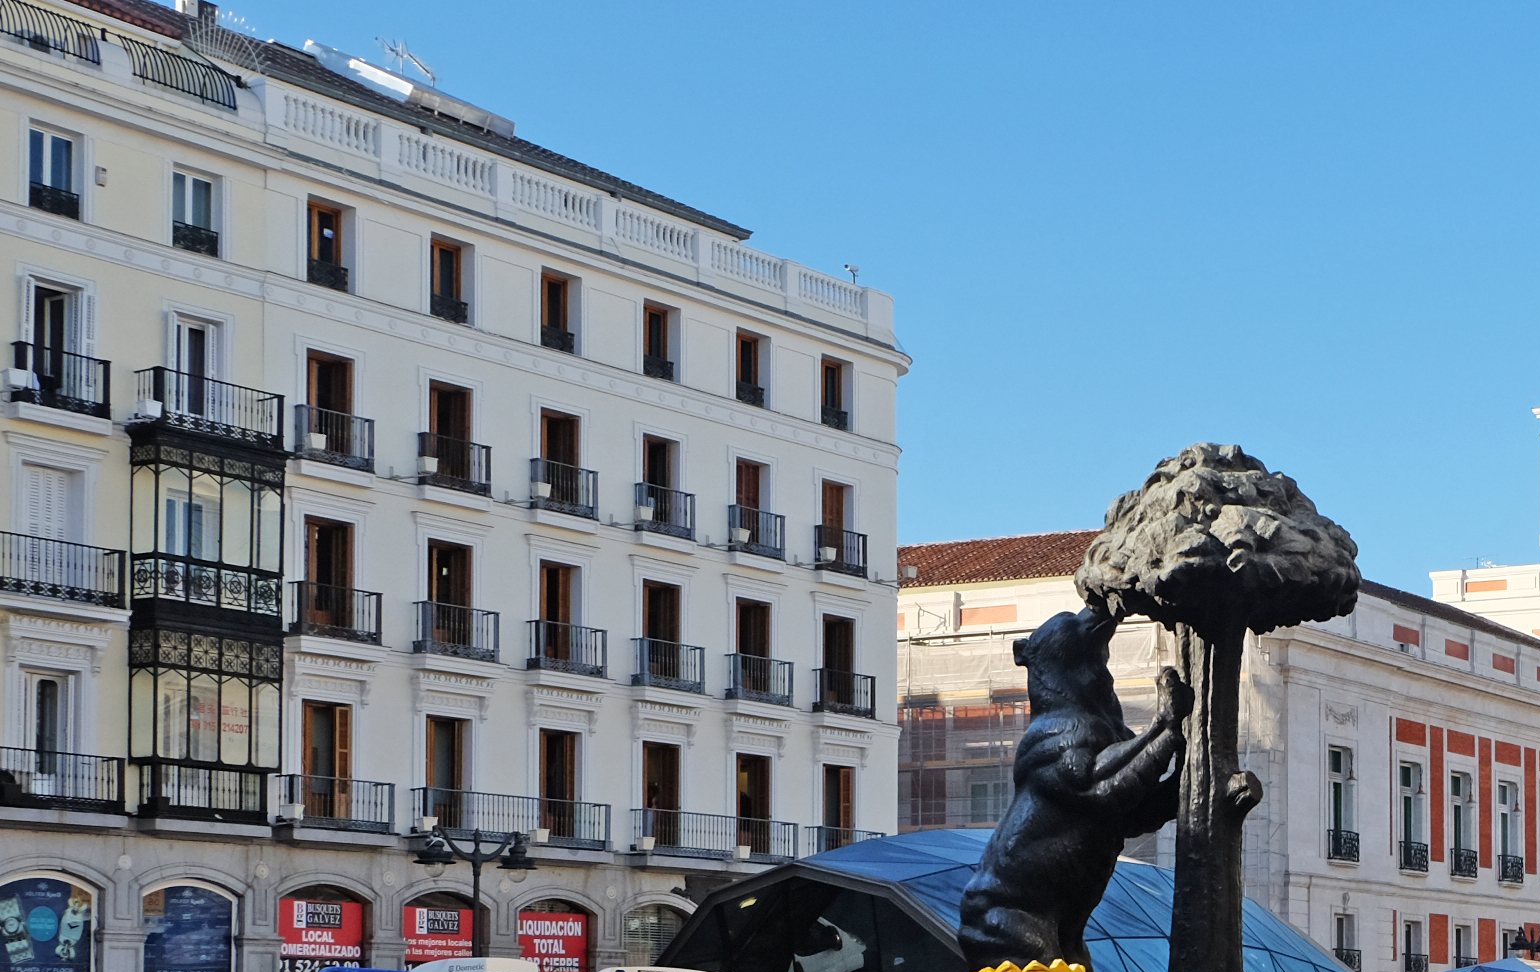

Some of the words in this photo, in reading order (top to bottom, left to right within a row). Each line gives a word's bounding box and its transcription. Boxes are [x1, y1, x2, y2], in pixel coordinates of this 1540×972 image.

[307, 903, 341, 914] BUSQUETS
[307, 913, 341, 924] GALVEZ
[428, 910, 459, 920] BUSQUETS
[428, 920, 458, 930] GALVEZ
[518, 917, 582, 936] LIQUIDACIÓN
[302, 930, 335, 943] LOCAL
[418, 938, 447, 947] mejores
[447, 938, 473, 947] locales
[533, 938, 566, 954] TOTAL
[281, 943, 361, 958] OMERCIALIZADO
[412, 947, 424, 955] las
[424, 948, 453, 957] mejores
[455, 963, 485, 972] Dometic
[543, 957, 580, 972] CIERRE
